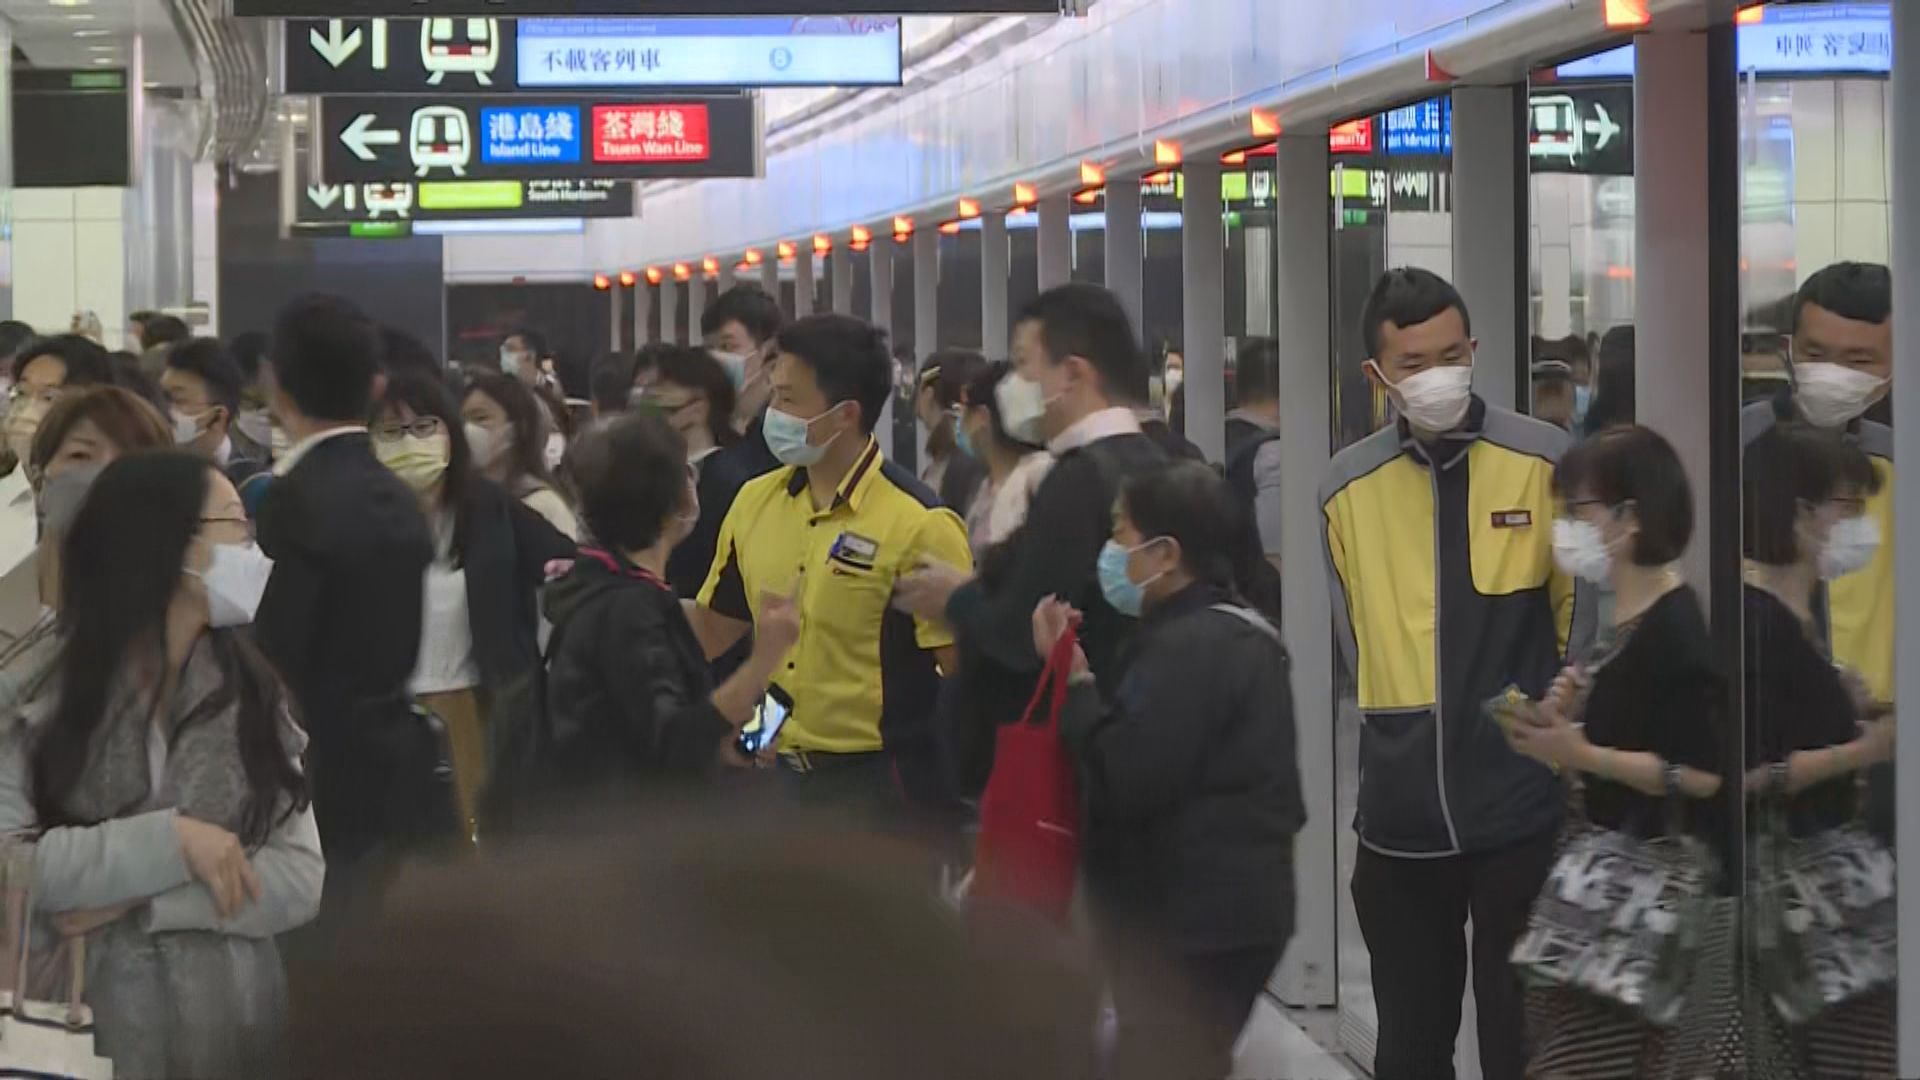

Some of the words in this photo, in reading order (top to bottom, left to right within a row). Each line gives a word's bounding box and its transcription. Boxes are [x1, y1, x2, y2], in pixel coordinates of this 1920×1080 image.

[543, 47, 661, 73] 不載客列車
[490, 141, 529, 157] Island
[532, 141, 561, 157] Line
[602, 141, 641, 156] Tsuen
[643, 141, 673, 156] Wan
[674, 141, 704, 156] Line
[528, 190, 559, 202] South
